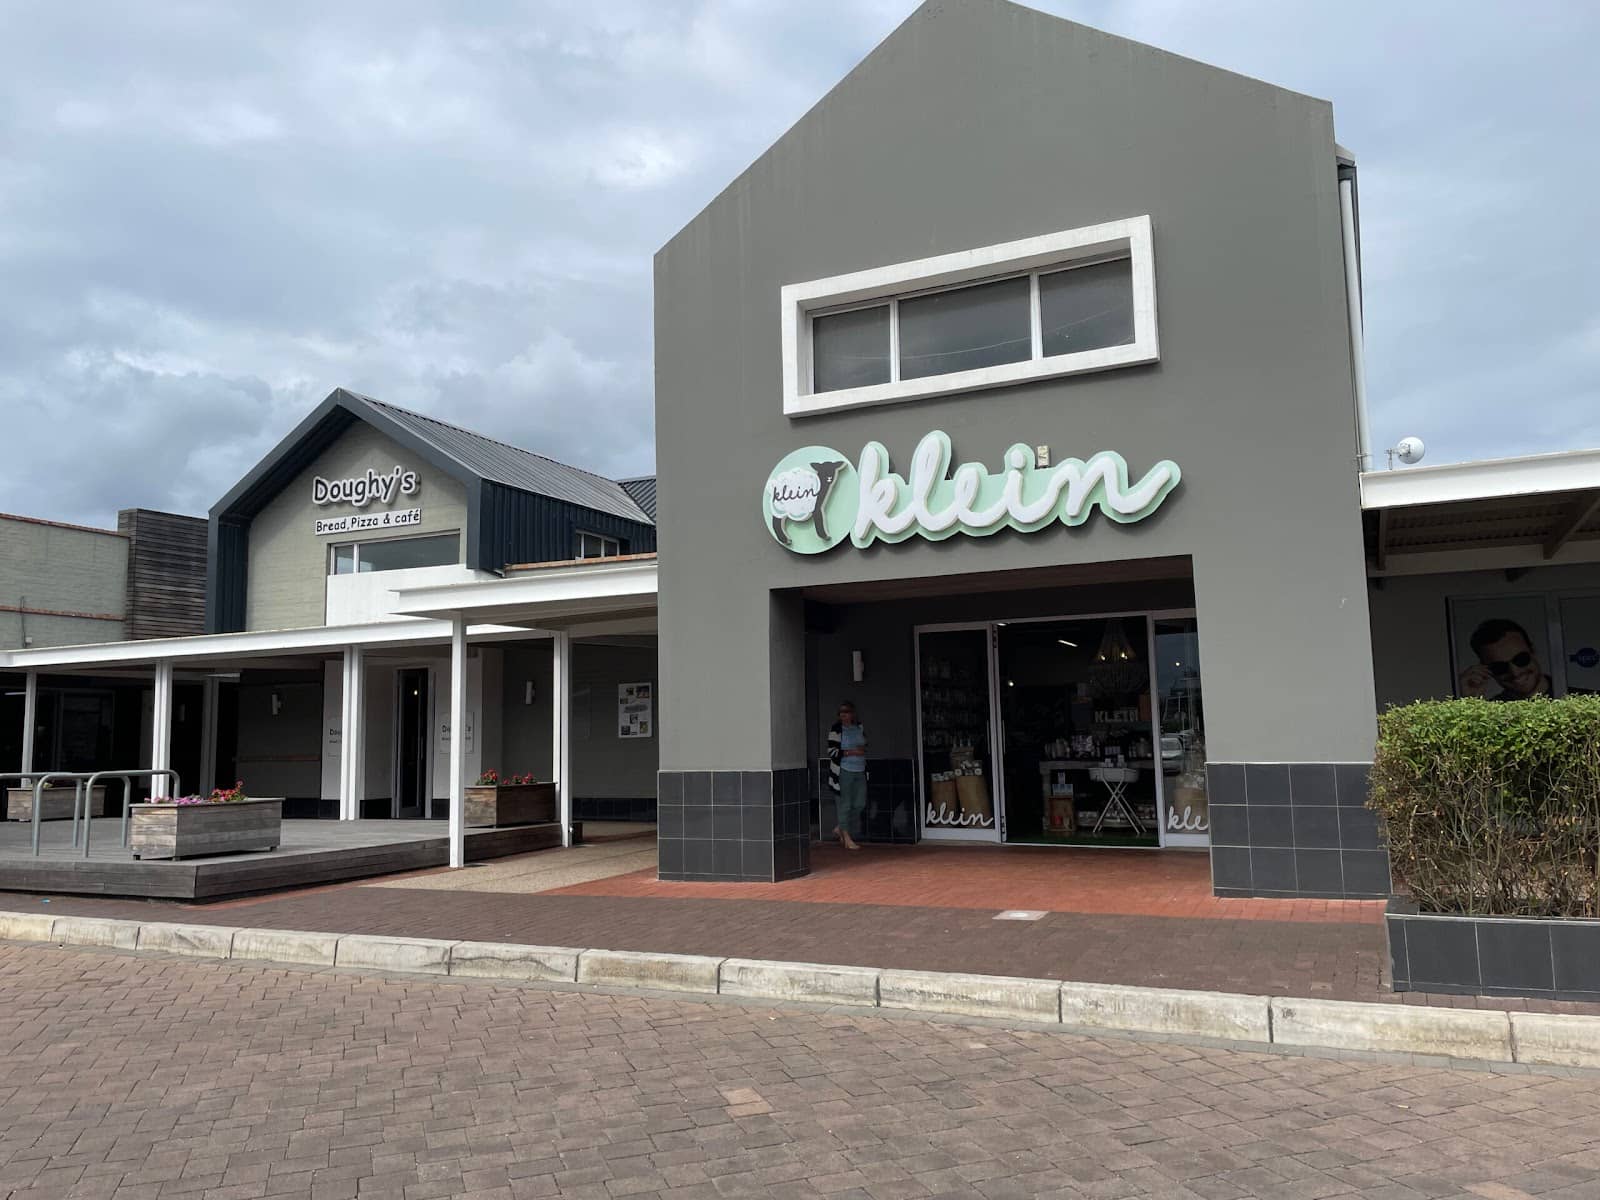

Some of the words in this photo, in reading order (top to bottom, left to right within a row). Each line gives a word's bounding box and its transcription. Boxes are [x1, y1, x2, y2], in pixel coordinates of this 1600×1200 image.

[313, 466, 416, 505] Doughy's
[772, 485, 819, 504] klein
[855, 436, 1171, 540] klein
[383, 513, 390, 524] &
[395, 509, 419, 524] café
[926, 801, 994, 828] klein
[1167, 805, 1209, 831] kle
